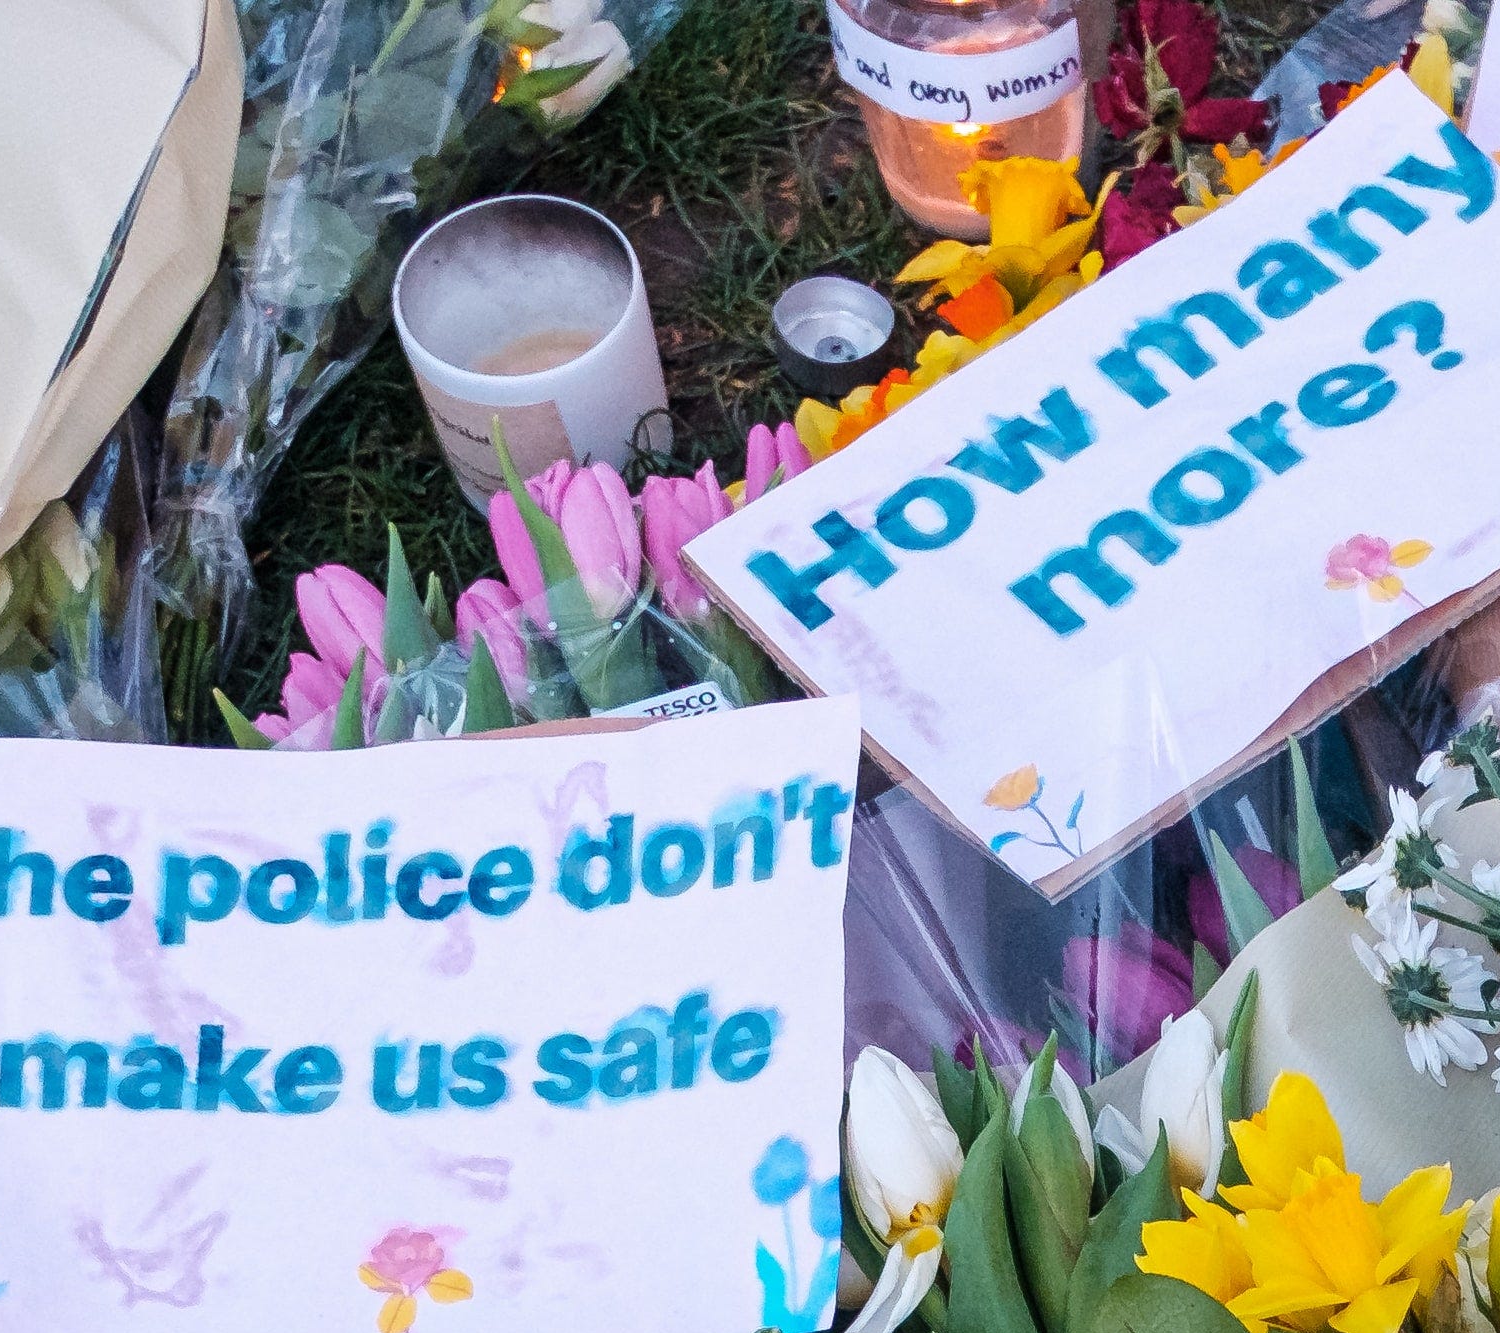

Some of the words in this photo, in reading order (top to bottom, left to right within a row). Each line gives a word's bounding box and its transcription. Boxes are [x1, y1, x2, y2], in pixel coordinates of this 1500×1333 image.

[856, 57, 892, 89] and
[910, 80, 970, 122] every
[986, 56, 1079, 102] womxn
[745, 387, 1097, 632] How
[1095, 121, 1498, 410] many
[1007, 298, 1467, 638] more?
[644, 691, 716, 717] TESCO
[156, 818, 534, 946] police
[554, 774, 852, 914] don't
[372, 1030, 512, 1114] us
[530, 989, 783, 1108] safe
